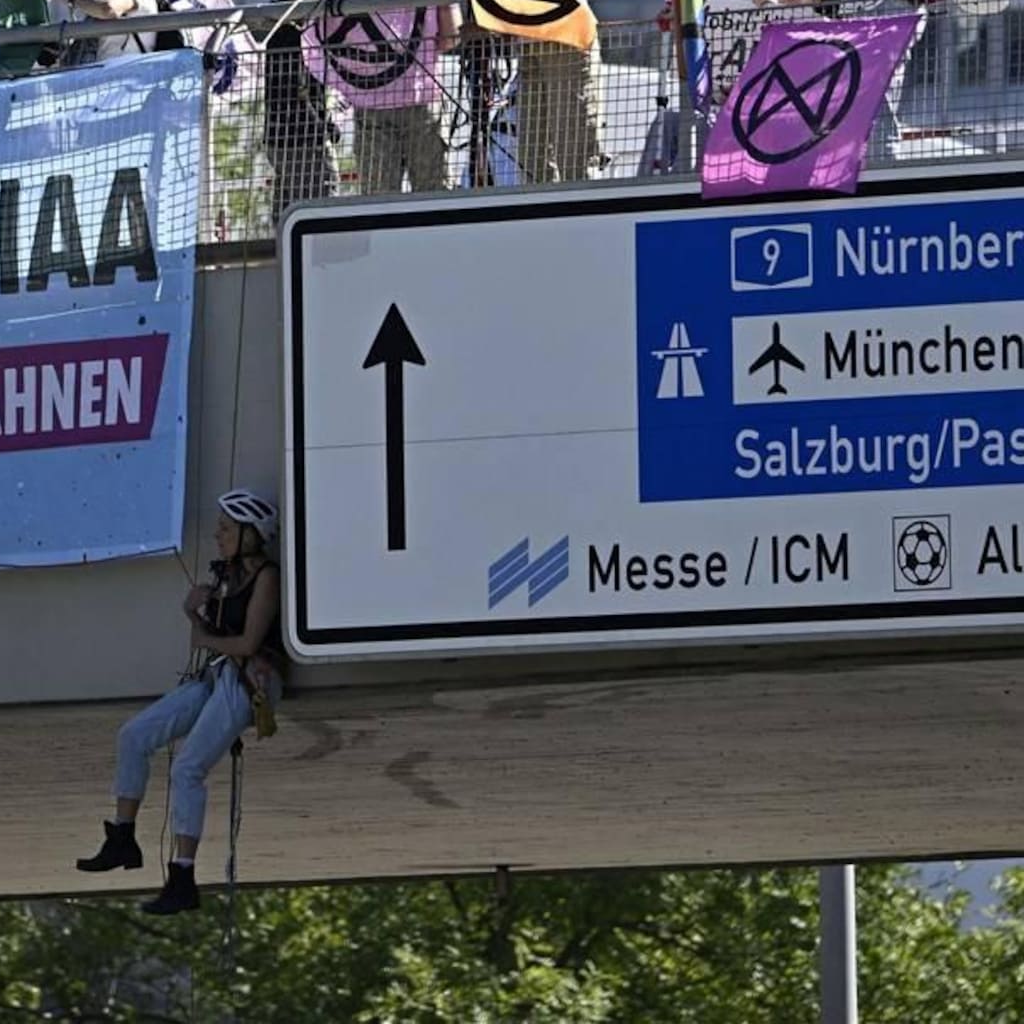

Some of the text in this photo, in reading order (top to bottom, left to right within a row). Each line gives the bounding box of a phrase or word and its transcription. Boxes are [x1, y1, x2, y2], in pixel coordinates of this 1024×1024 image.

[762, 238, 781, 276] 9
[836, 221, 1024, 277] Nürnber
[825, 325, 1024, 380] München
[587, 543, 728, 593] Messe
[771, 532, 850, 584] ICM
